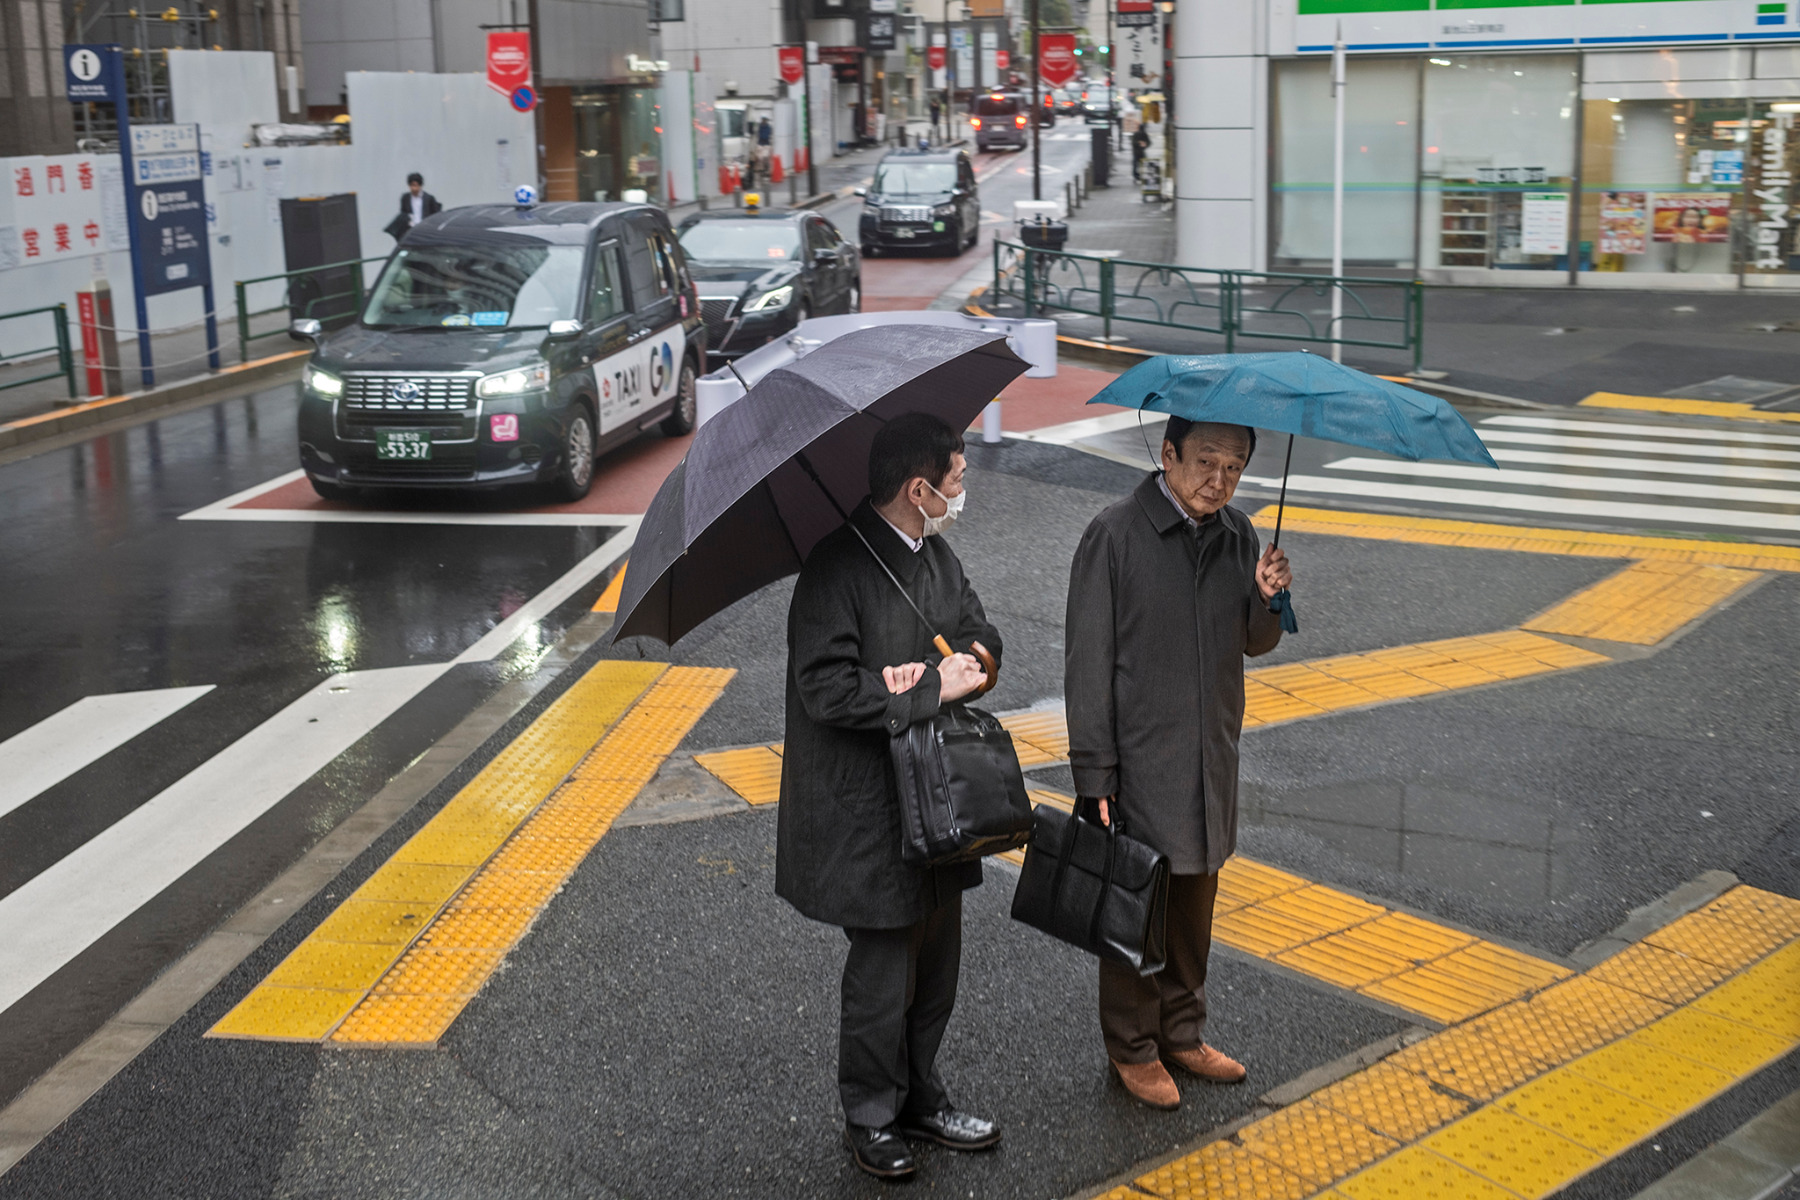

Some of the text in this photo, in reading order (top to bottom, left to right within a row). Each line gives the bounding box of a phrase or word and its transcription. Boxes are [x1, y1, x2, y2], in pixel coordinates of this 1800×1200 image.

[1753, 112, 1794, 269] FamilyMart
[22, 218, 100, 258] 営業中
[614, 341, 673, 402] TAXI GO
[387, 442, 429, 458] 53-37
